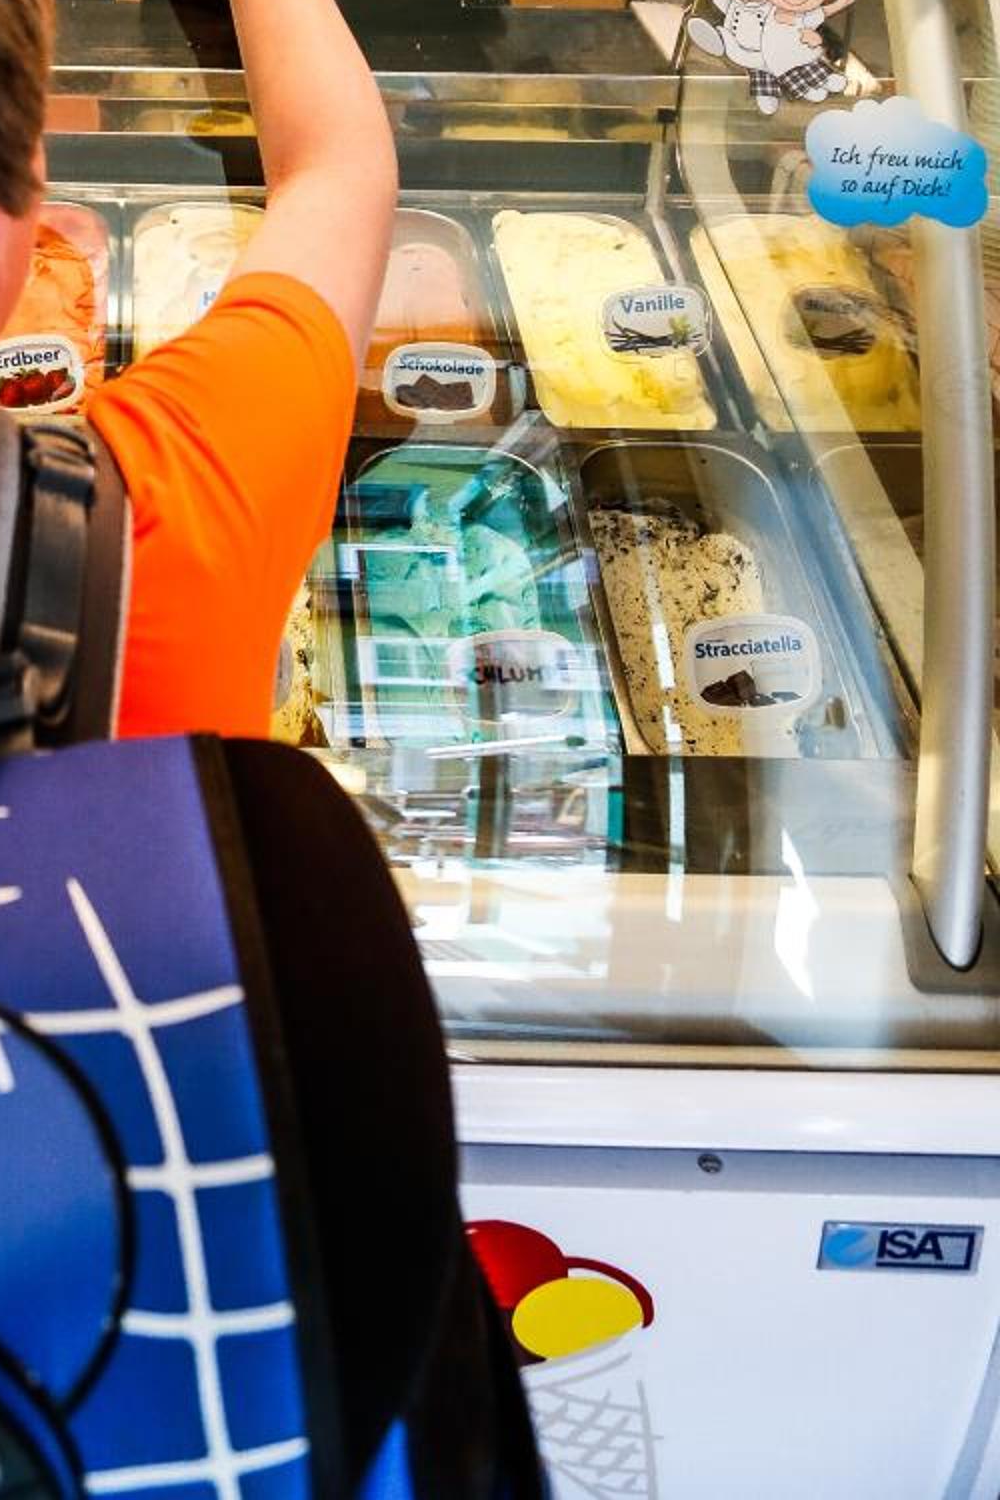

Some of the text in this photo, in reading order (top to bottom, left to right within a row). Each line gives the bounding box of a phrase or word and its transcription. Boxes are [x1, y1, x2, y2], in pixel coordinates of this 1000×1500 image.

[830, 144, 964, 177] Ich freu mich
[841, 175, 952, 204] so auf Dich!
[620, 294, 685, 315] Vanille
[399, 356, 484, 376] Schokolade
[695, 635, 802, 659] Stracciatella
[877, 1229, 944, 1261] ISA
